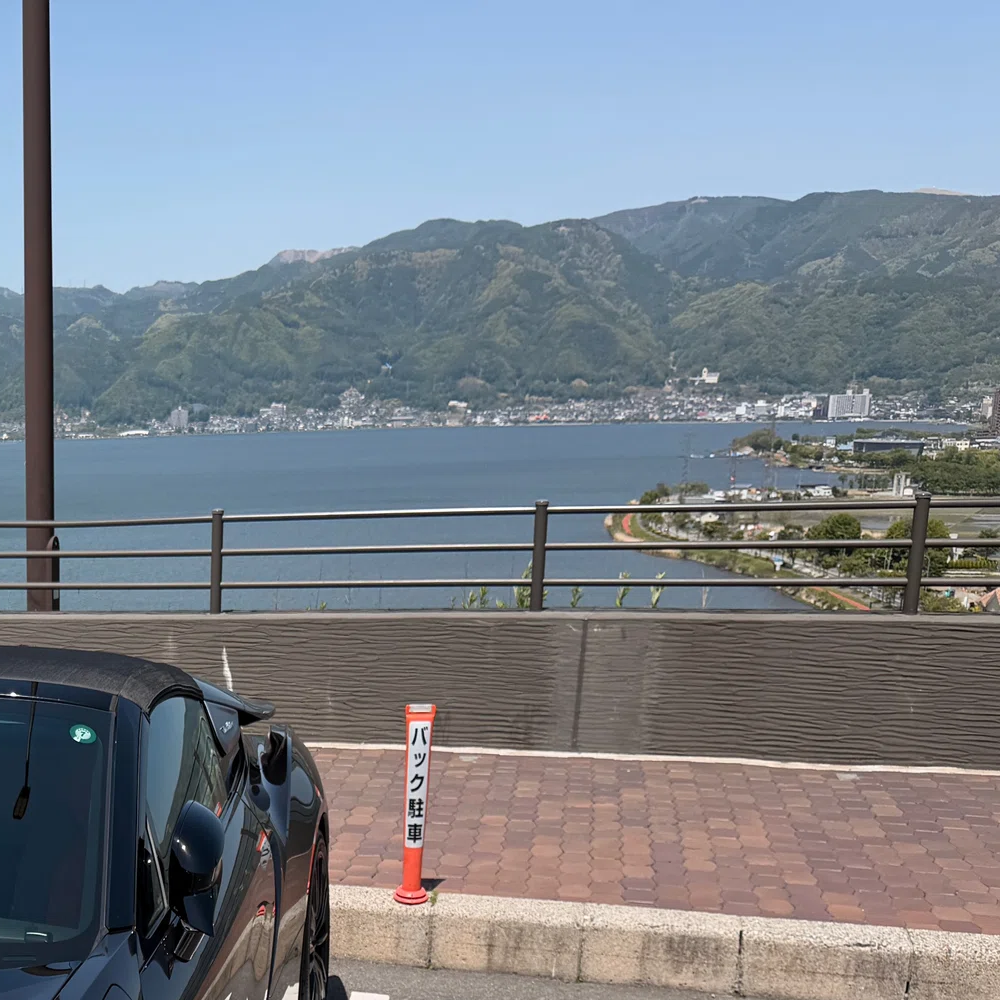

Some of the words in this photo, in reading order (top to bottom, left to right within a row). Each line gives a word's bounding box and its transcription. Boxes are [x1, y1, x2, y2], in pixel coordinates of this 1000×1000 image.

[407, 726, 428, 844] バック駐車
